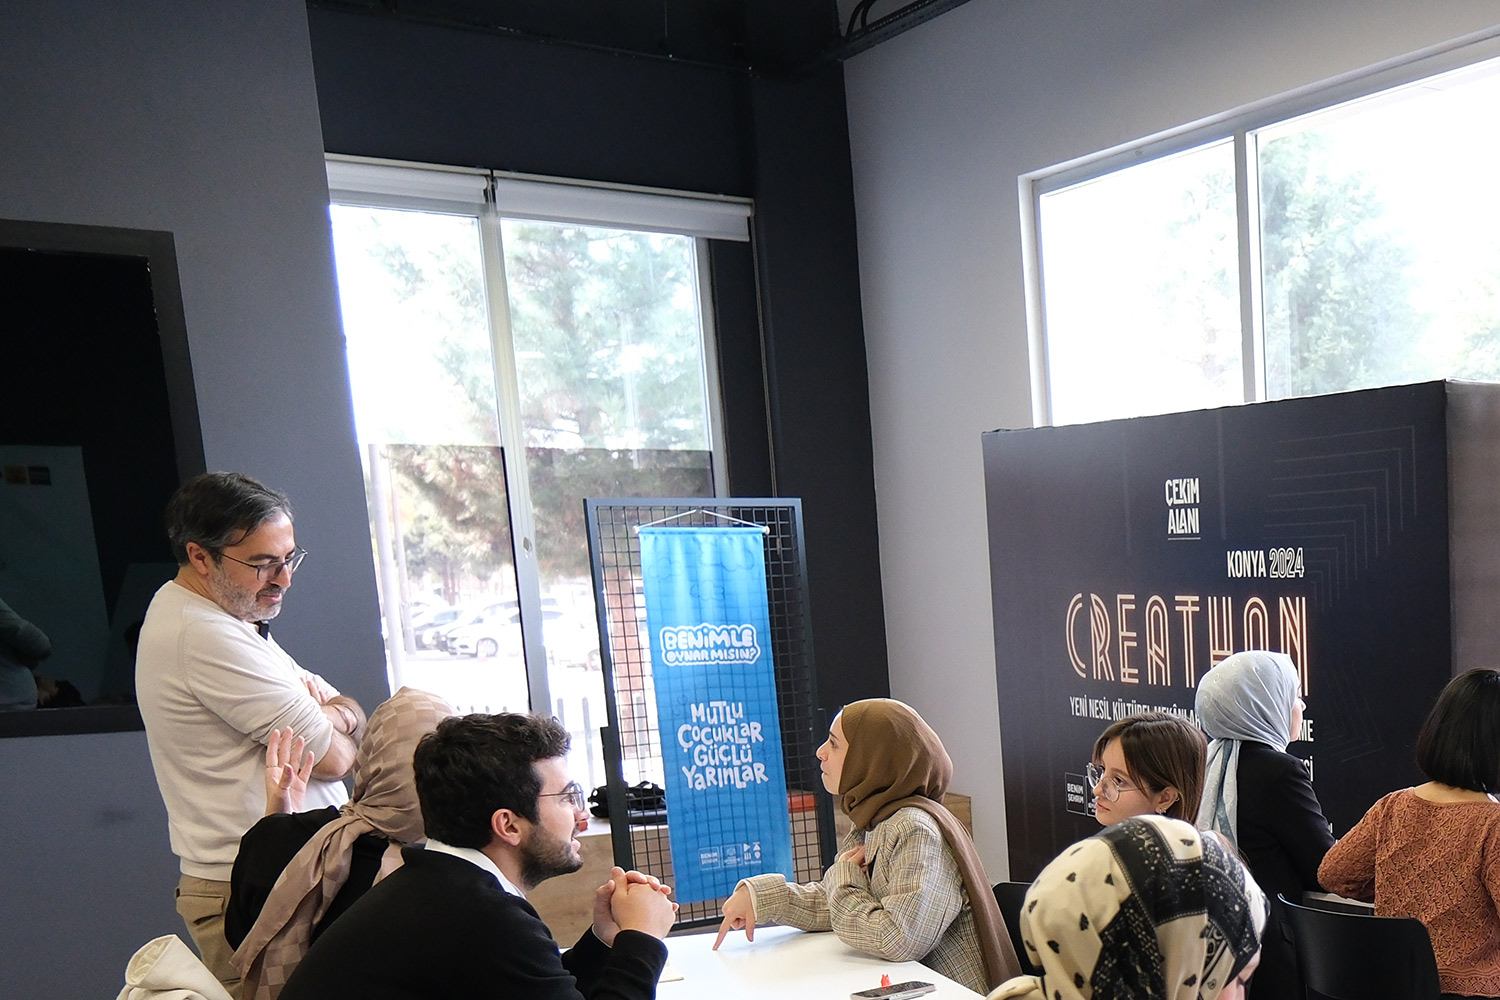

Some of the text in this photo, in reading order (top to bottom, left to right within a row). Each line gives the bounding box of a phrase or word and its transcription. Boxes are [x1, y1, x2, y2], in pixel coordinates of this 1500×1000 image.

[1168, 508, 1200, 534] ALANI
[1227, 547, 1304, 578] KONYA 2024
[667, 651, 709, 662] OYNAR
[1066, 593, 1308, 697] CREATHON
[691, 701, 744, 725] MUTLU
[1070, 695, 1088, 716] YENİ
[1089, 697, 1112, 720] NESİL
